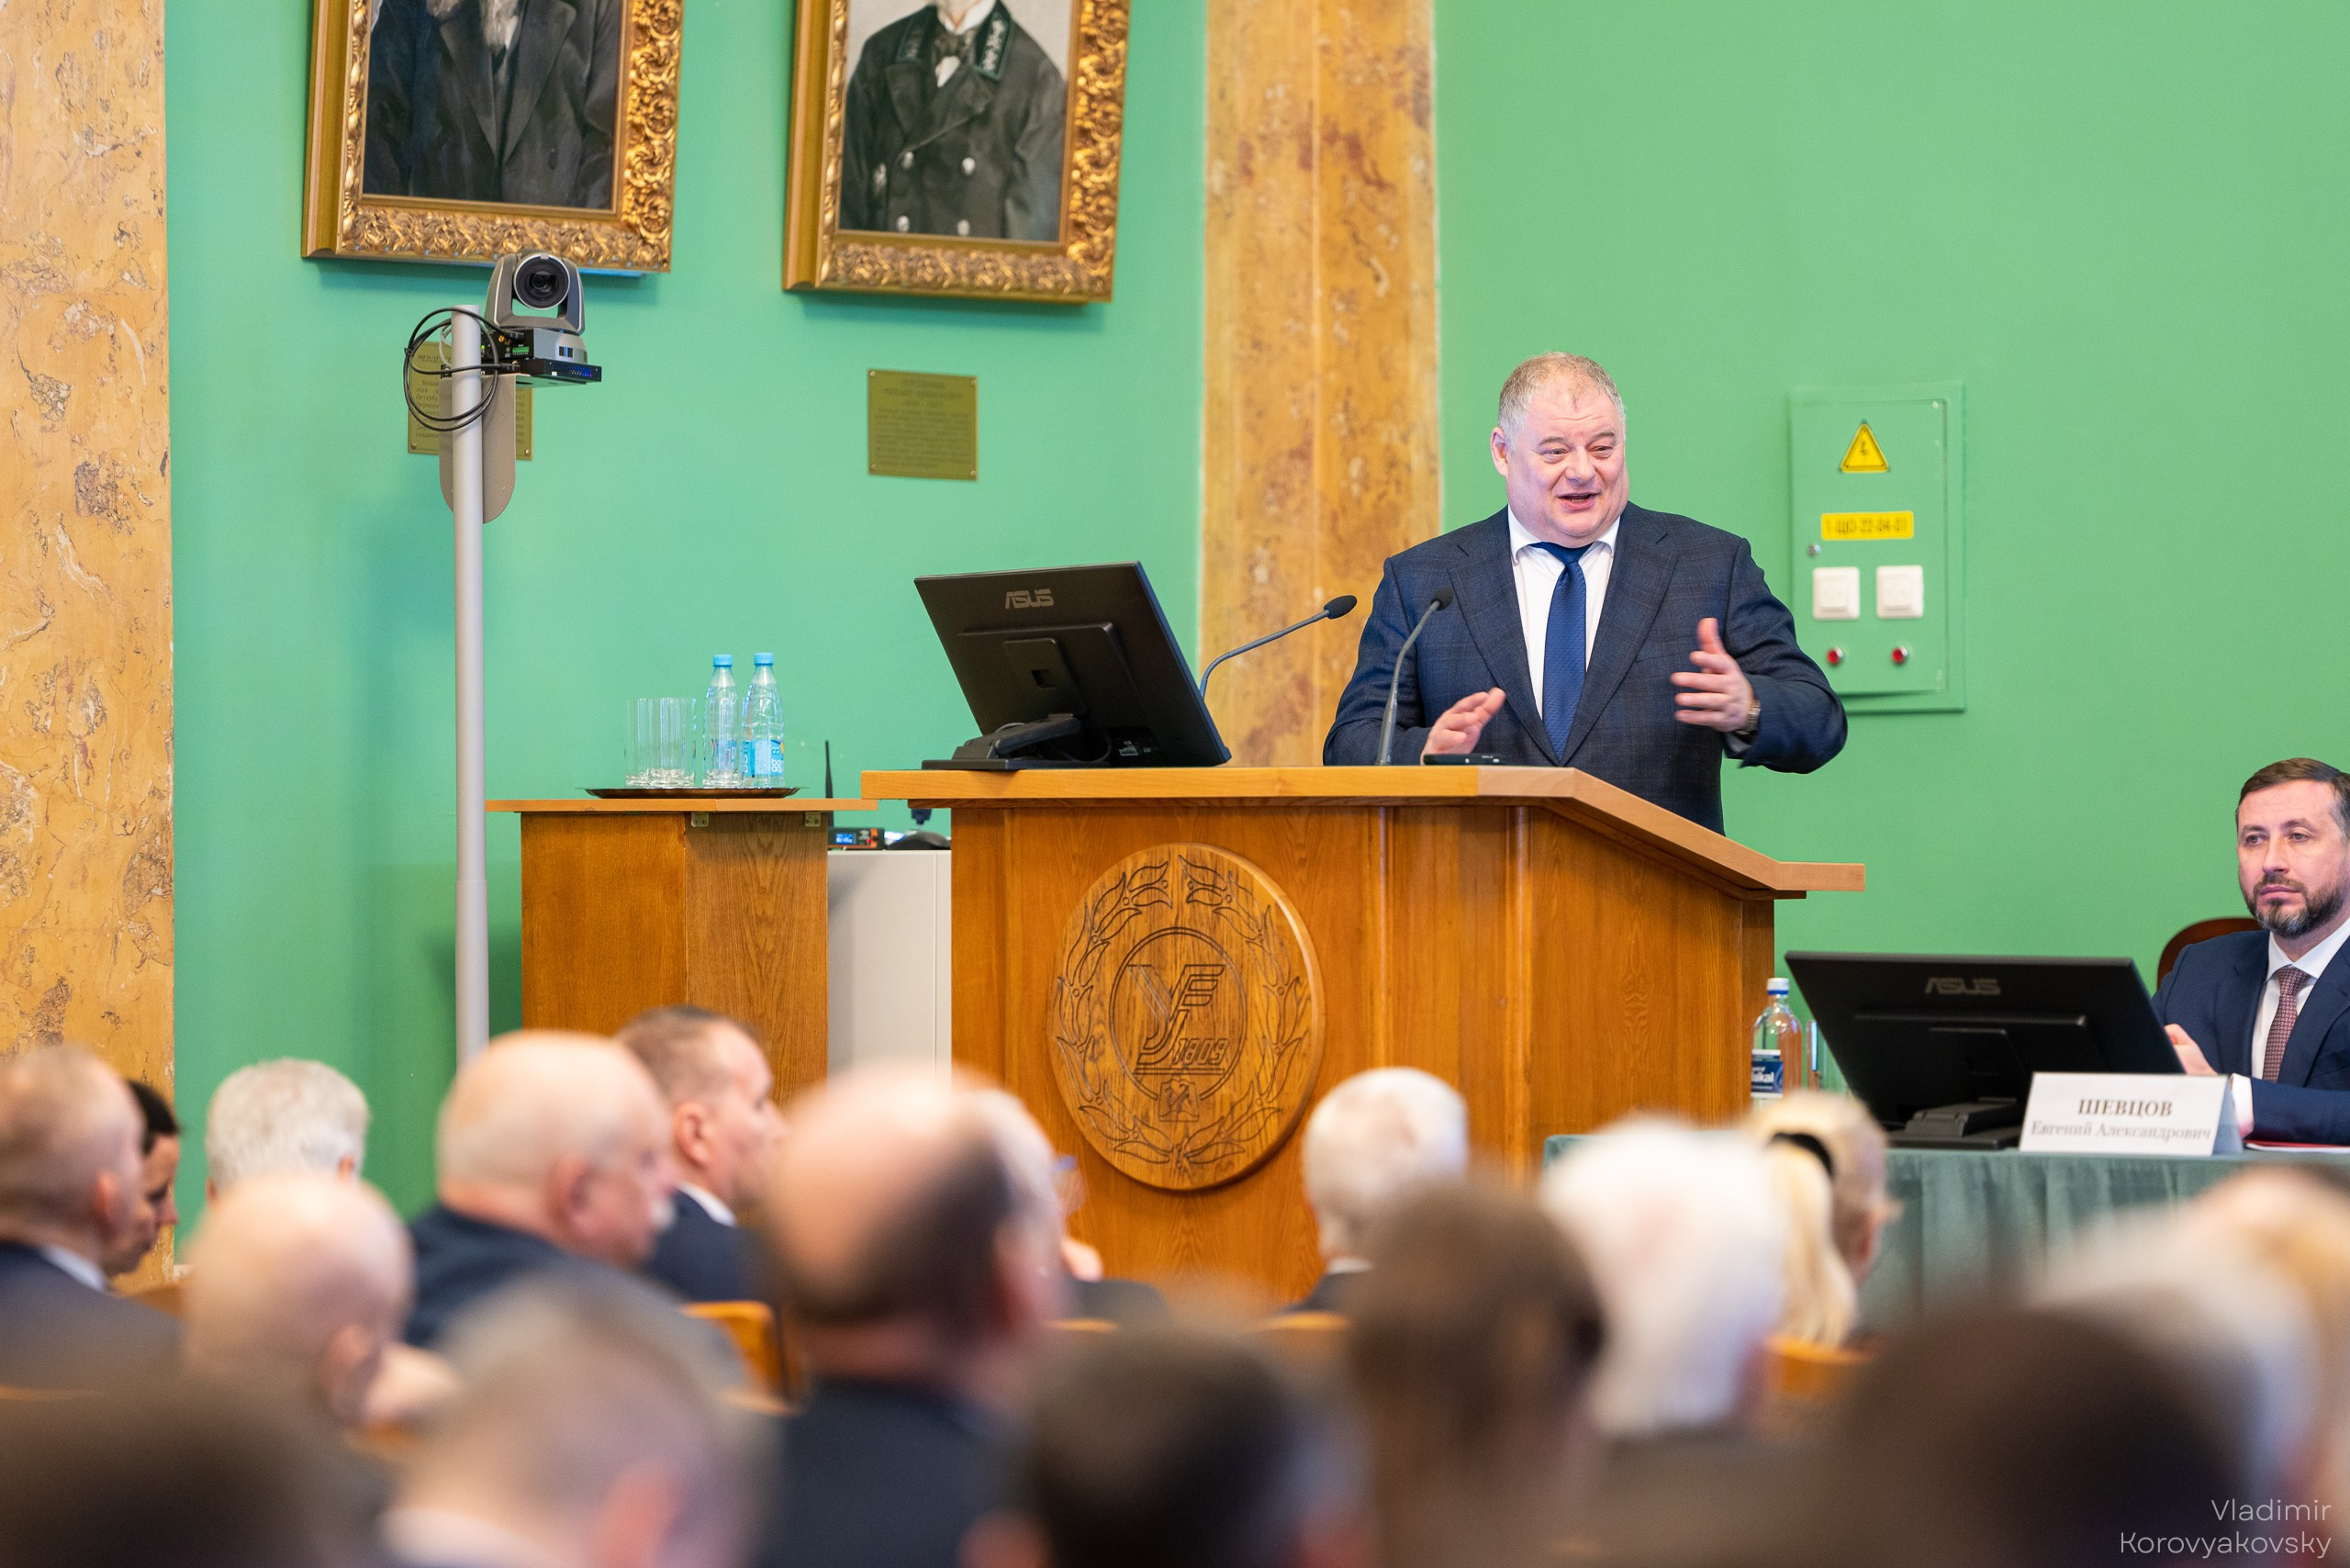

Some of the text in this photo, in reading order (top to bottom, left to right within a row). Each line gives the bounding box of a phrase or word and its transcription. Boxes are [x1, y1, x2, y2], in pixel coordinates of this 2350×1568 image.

[1004, 588, 1055, 610] ASUS
[1924, 977, 2001, 995] ASUS
[1172, 1037, 1229, 1066] 1809
[2077, 1099, 2174, 1118] ШЕВЦОВ
[2031, 1120, 2211, 1142] Евгений Александрович
